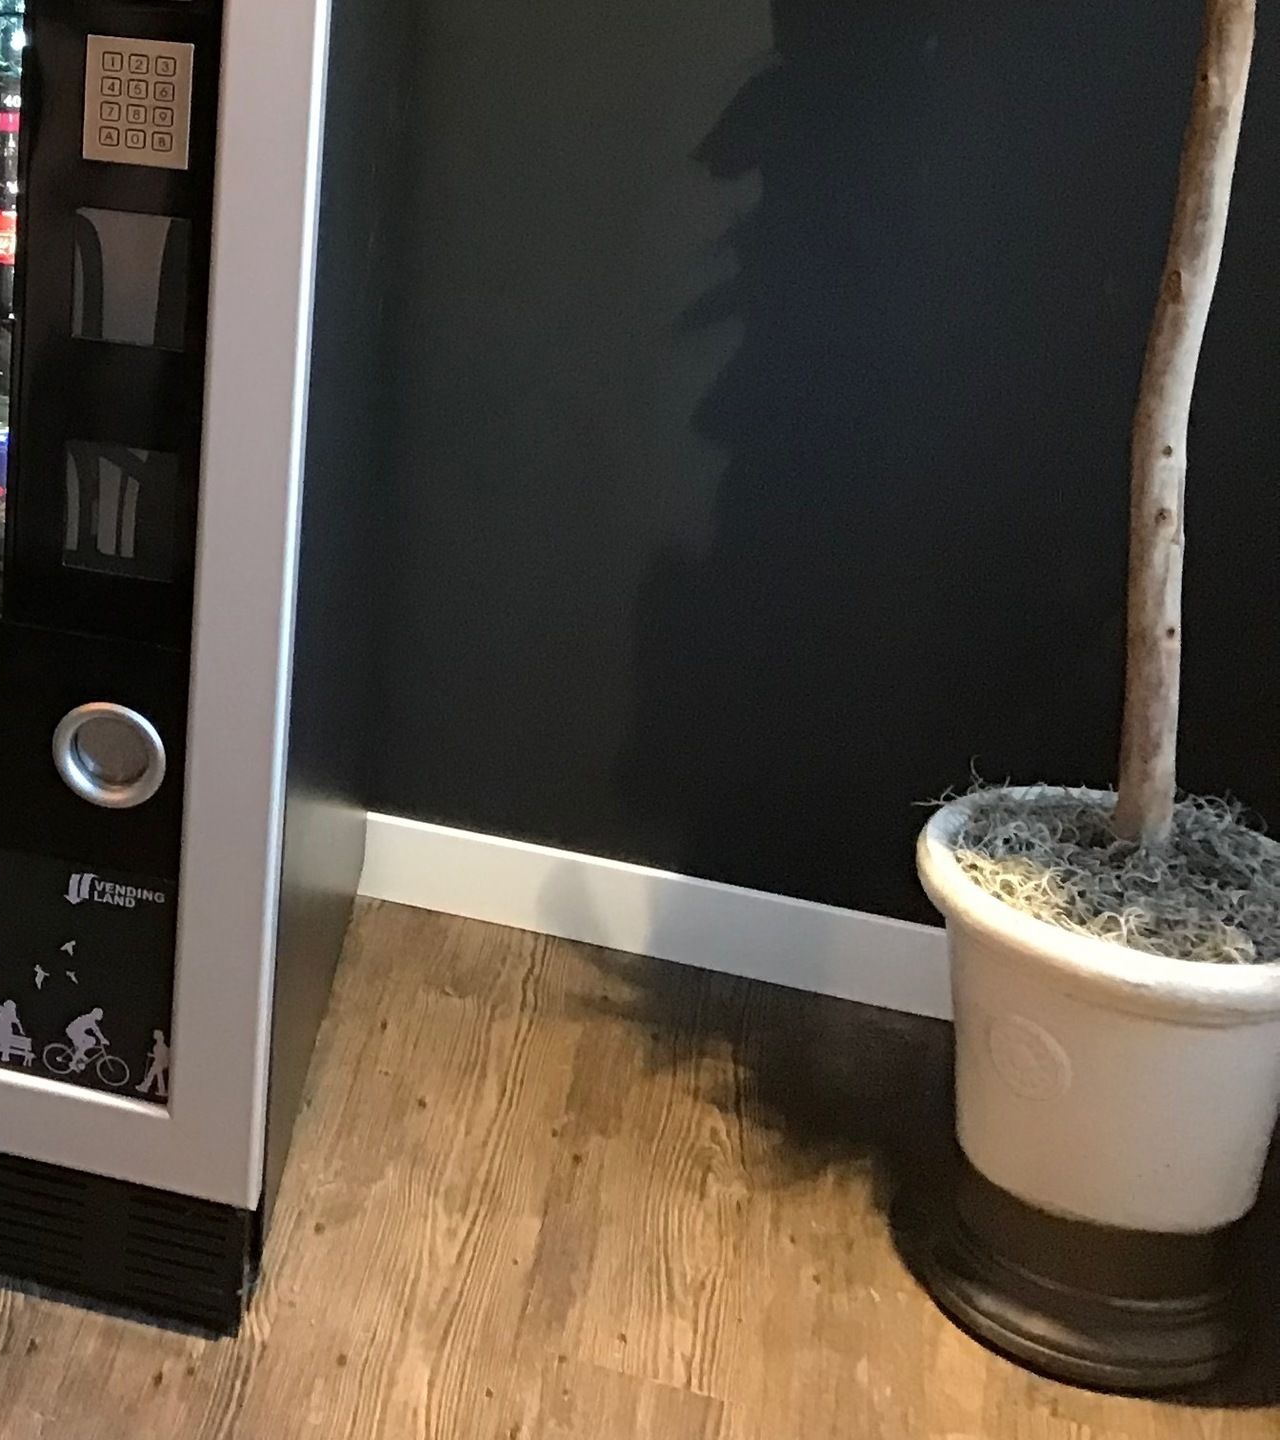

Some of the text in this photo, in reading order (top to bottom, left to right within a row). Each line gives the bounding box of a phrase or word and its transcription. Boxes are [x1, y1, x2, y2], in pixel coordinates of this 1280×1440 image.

[134, 59, 143, 71] 2
[161, 61, 170, 73] 3
[107, 81, 169, 99] 4 5 6
[107, 106, 168, 122] 7 8 9
[103, 131, 114, 143] A
[93, 879, 166, 905] VENDING
[93, 890, 137, 909] LAND
